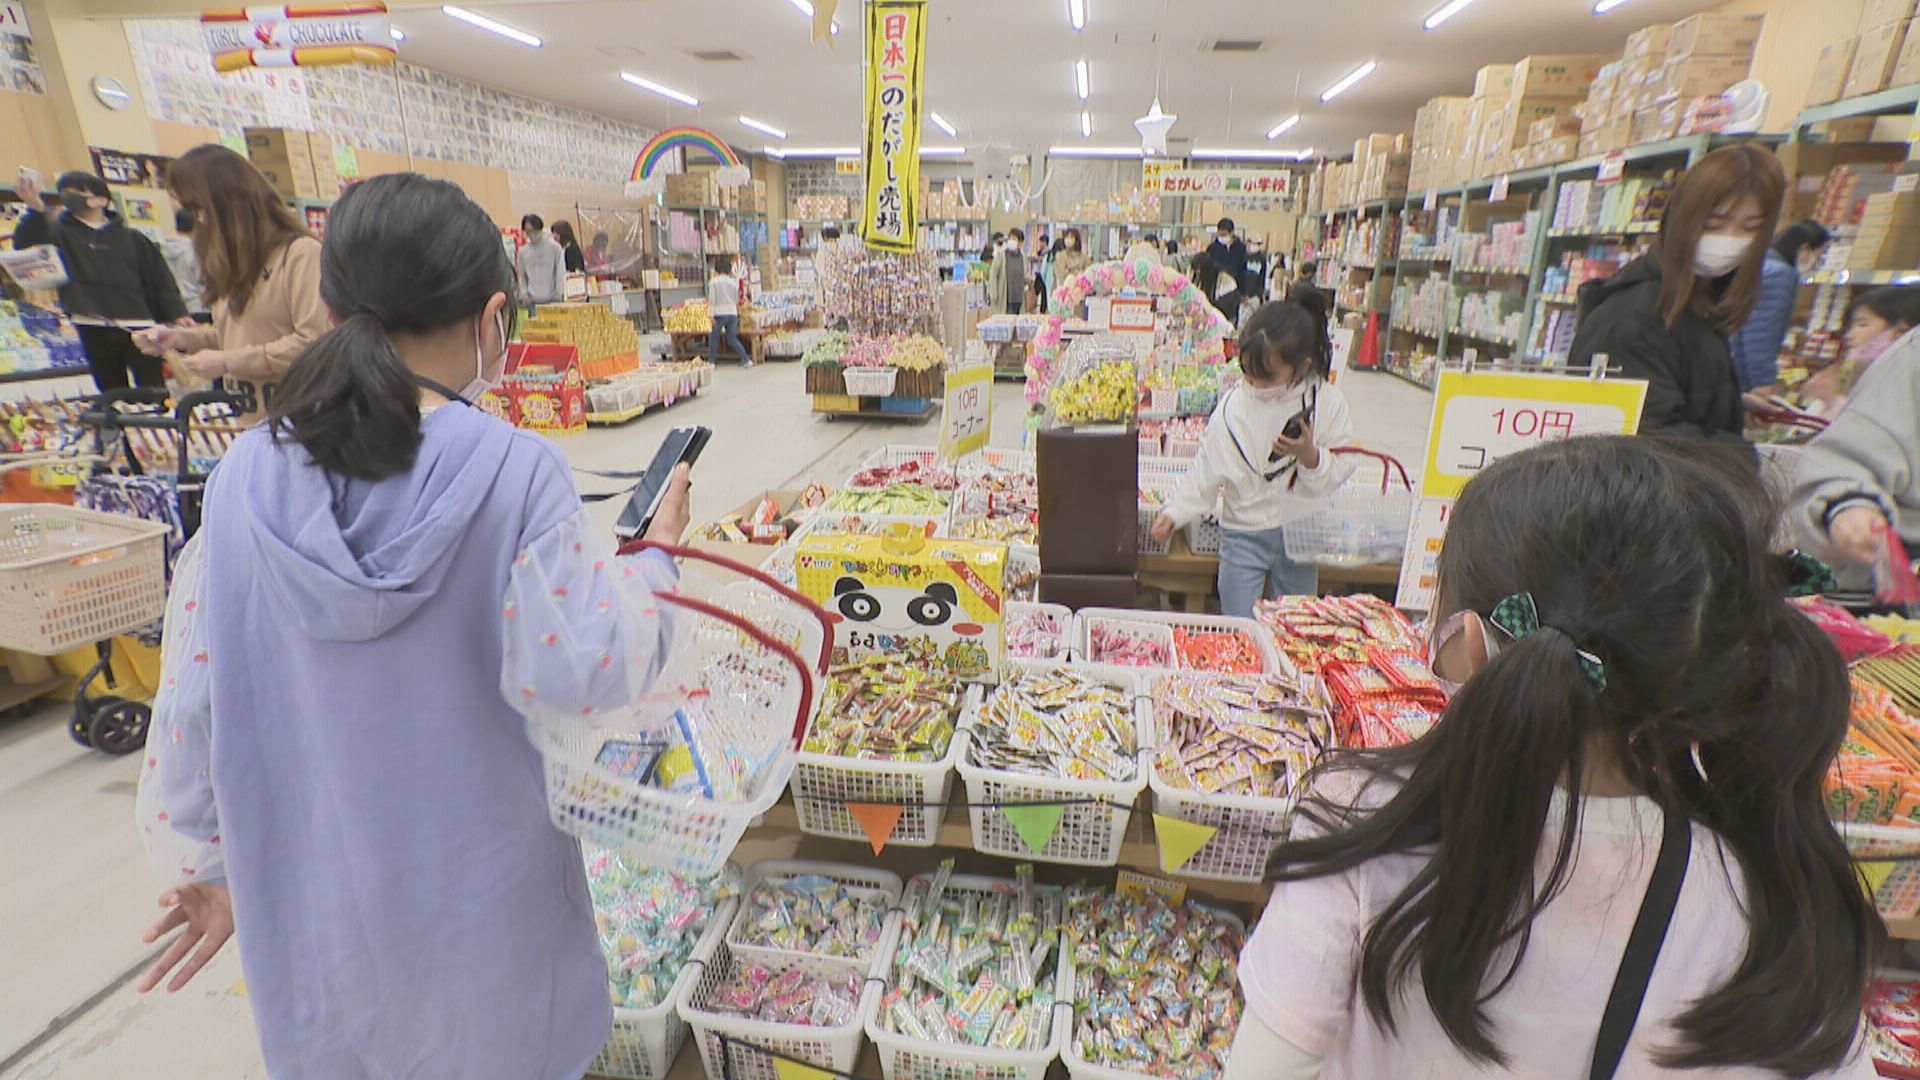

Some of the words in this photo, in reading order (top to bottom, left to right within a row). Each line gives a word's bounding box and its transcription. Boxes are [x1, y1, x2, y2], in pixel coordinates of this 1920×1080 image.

[288, 21, 364, 44] CHOCOLATE
[876, 14, 907, 237] 日本一のだがし売場
[958, 386, 978, 410] 10円
[953, 413, 983, 440] コーナー
[1492, 408, 1574, 440] 10円
